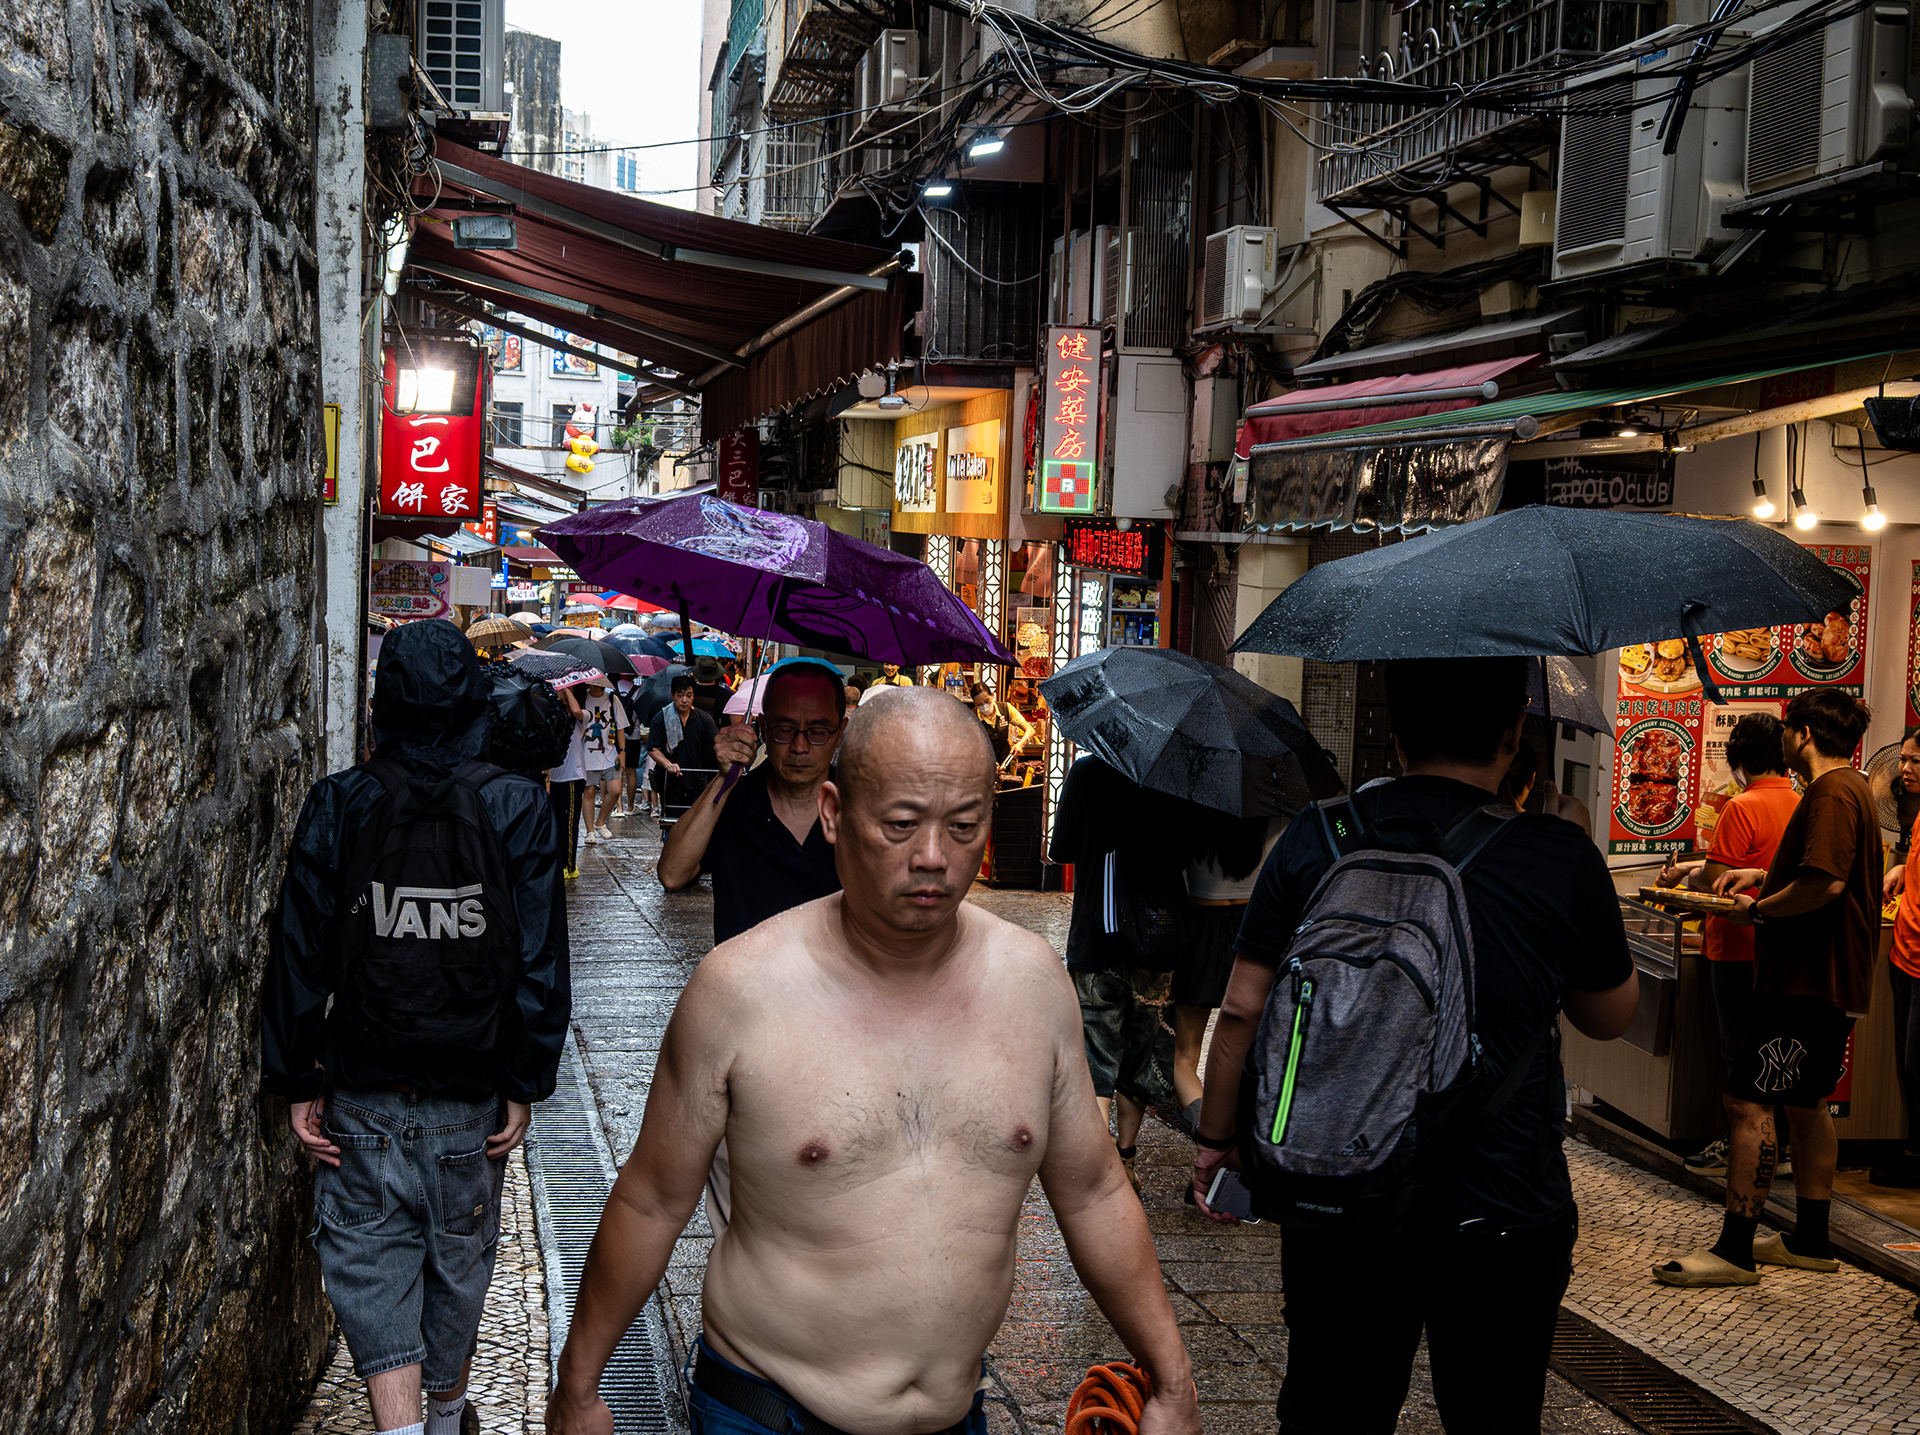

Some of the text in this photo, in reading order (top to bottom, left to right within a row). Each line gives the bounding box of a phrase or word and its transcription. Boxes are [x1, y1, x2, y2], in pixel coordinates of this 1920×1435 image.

[967, 452, 986, 481] Bakery
[391, 481, 469, 514] 餅家
[1728, 670, 1745, 680] BAKERY
[1761, 659, 1778, 675] BAKERY
[1807, 671, 1824, 680] BAKERY
[1840, 660, 1855, 675] BAKERY
[1617, 700, 1701, 716] 豬肉乾牛肉乾
[1638, 721, 1658, 730] BAKERY
[1675, 726, 1691, 743] BAKERY
[1633, 825, 1651, 835] BAKERY
[1667, 813, 1684, 830] BAKERY
[372, 881, 486, 938] VANS
[1755, 1038, 1807, 1092] NY
